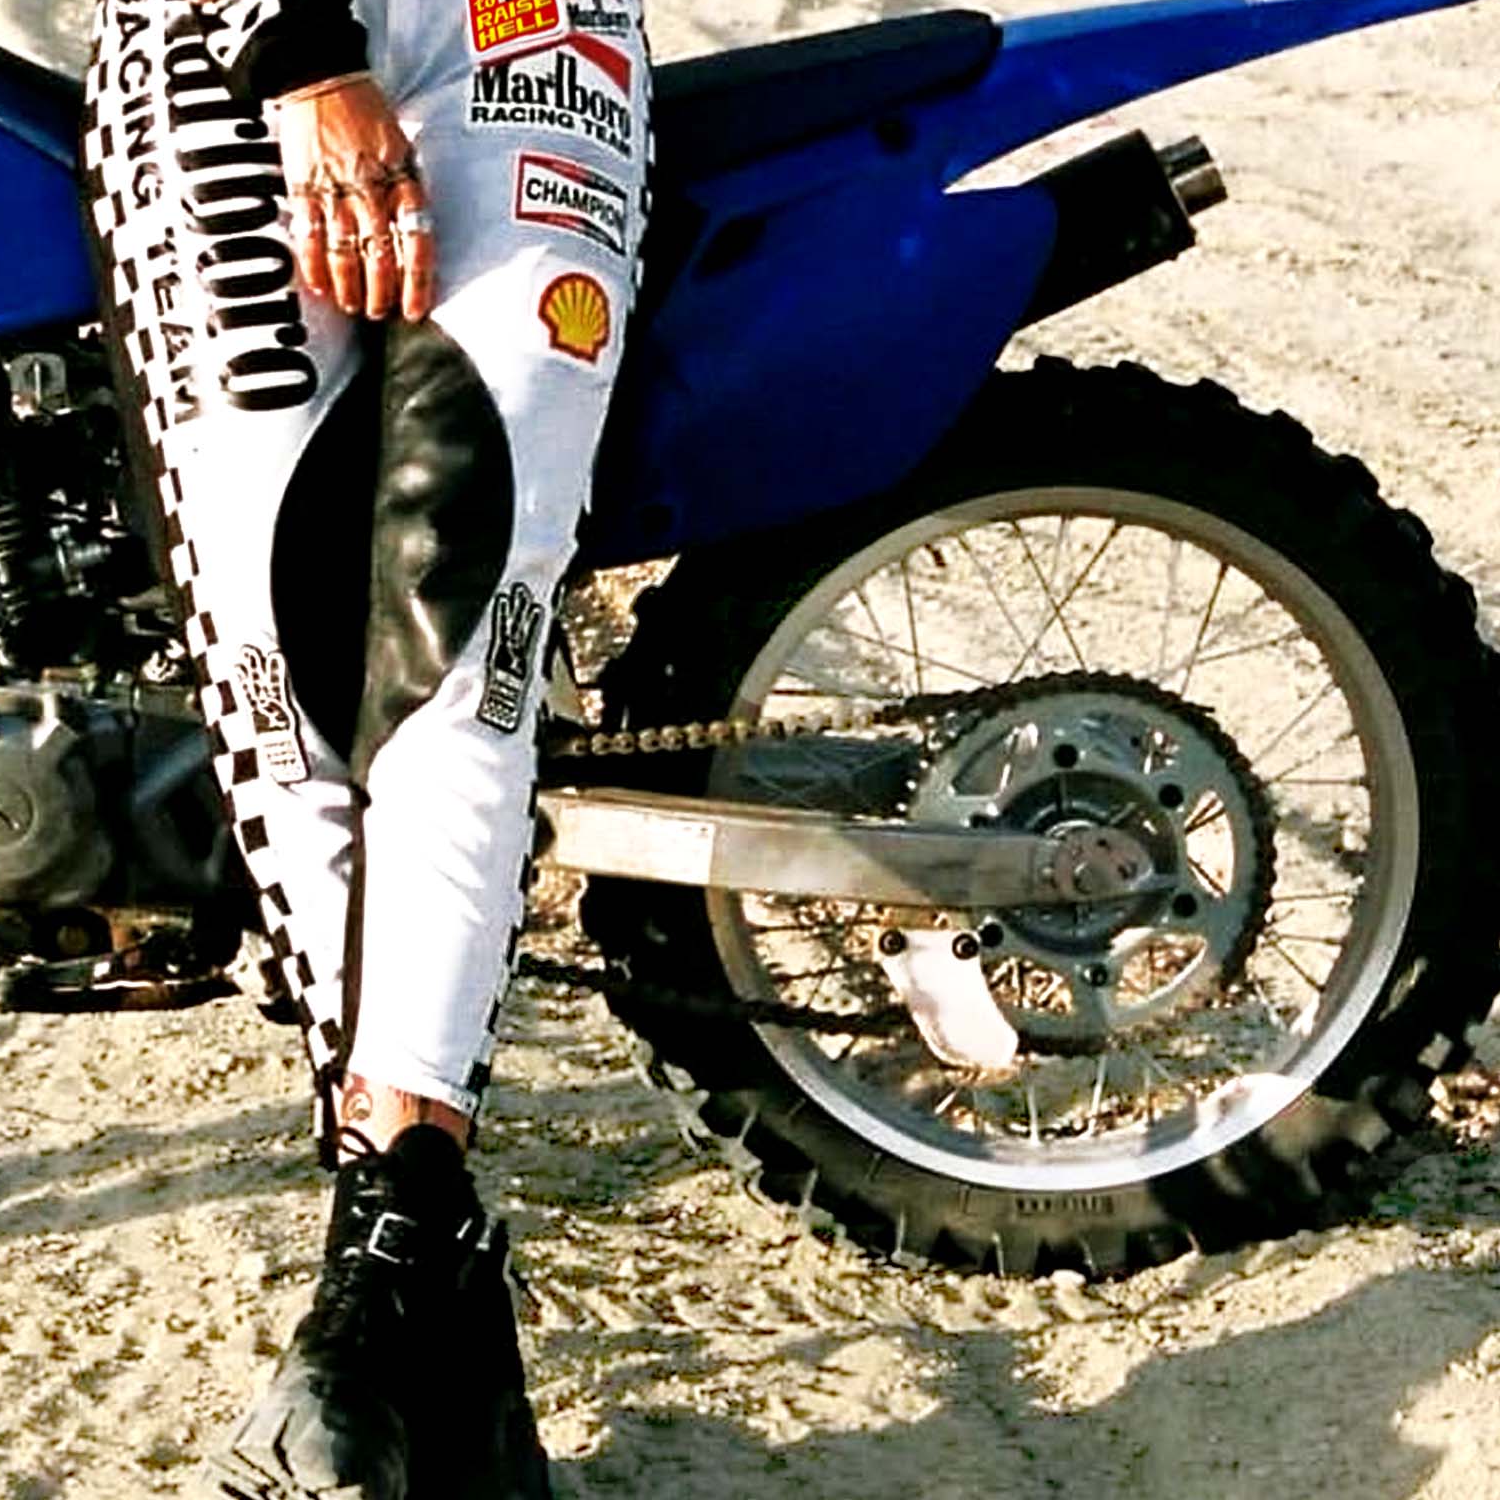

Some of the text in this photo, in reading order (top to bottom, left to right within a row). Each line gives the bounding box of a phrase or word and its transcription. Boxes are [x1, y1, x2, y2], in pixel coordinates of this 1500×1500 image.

[477, 12, 556, 50] HELL
[472, 50, 631, 139] Marlboro
[470, 106, 632, 158] RACING TEAM
[146, 227, 205, 422] TEAM
